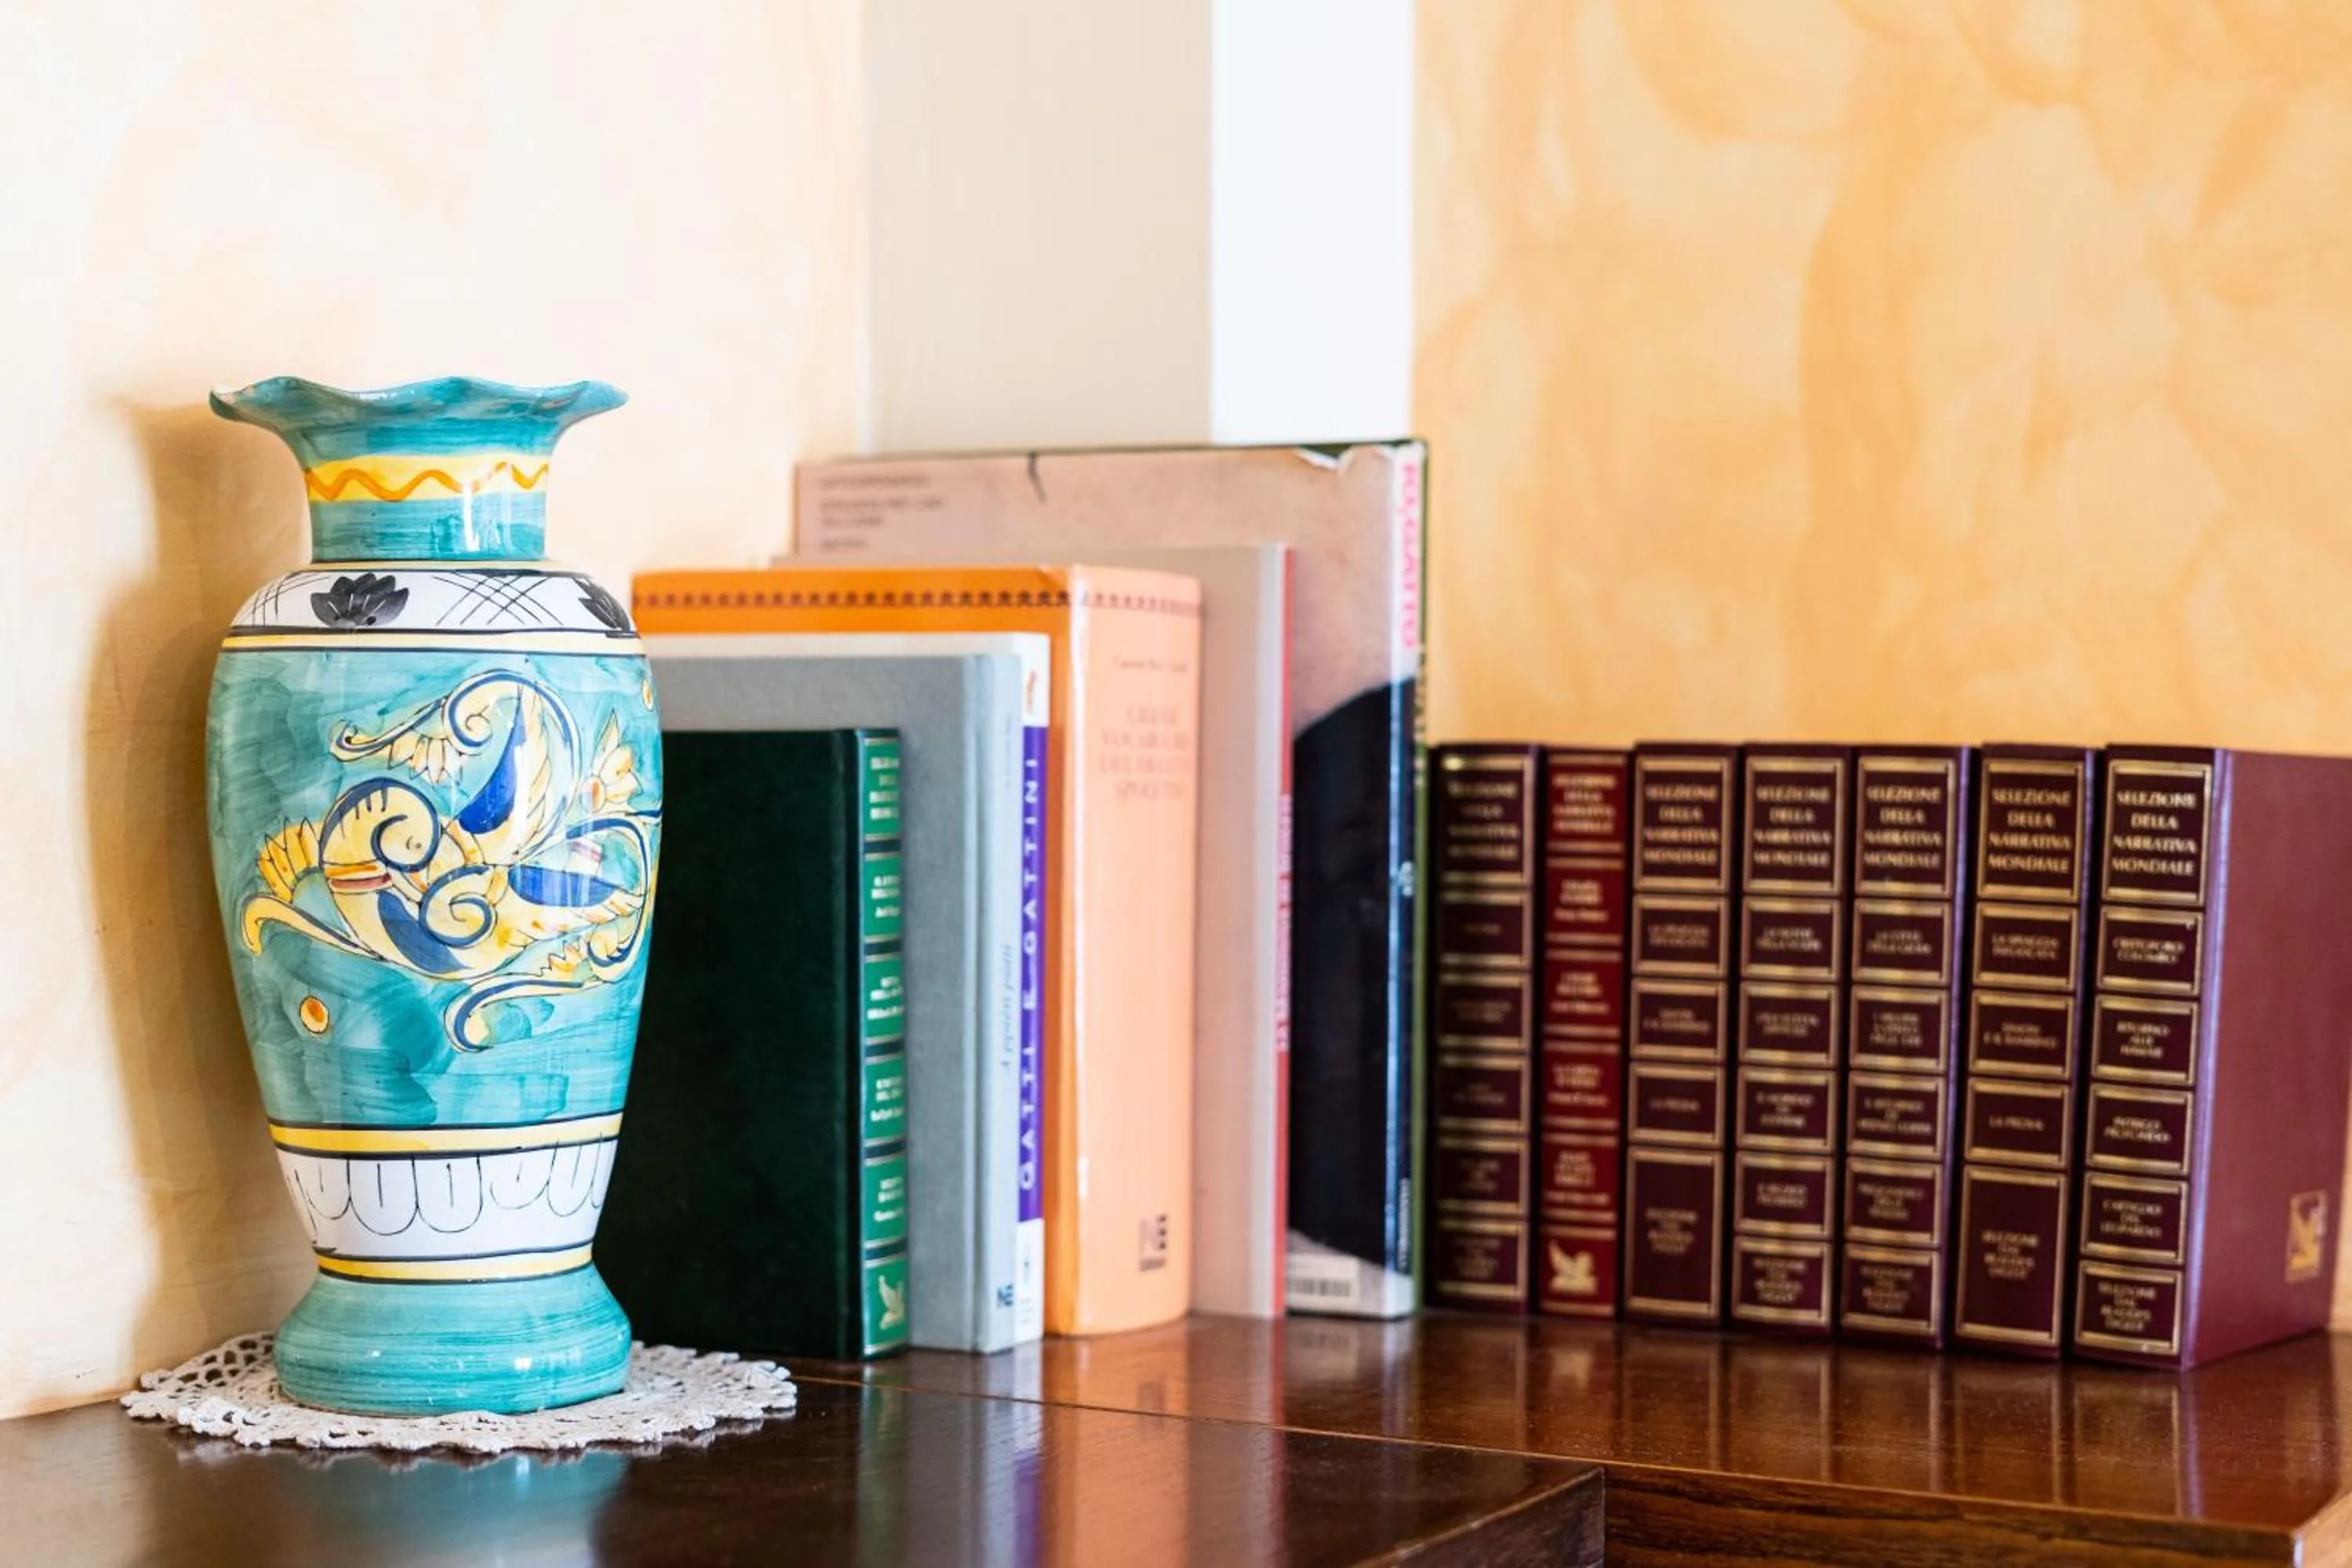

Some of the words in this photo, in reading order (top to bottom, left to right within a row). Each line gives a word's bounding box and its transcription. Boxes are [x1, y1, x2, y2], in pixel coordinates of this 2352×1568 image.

[2115, 789, 2198, 808] SELEZIONE
[2130, 812, 2180, 831] DELLA
[2113, 833, 2198, 855] NARRATIVA
